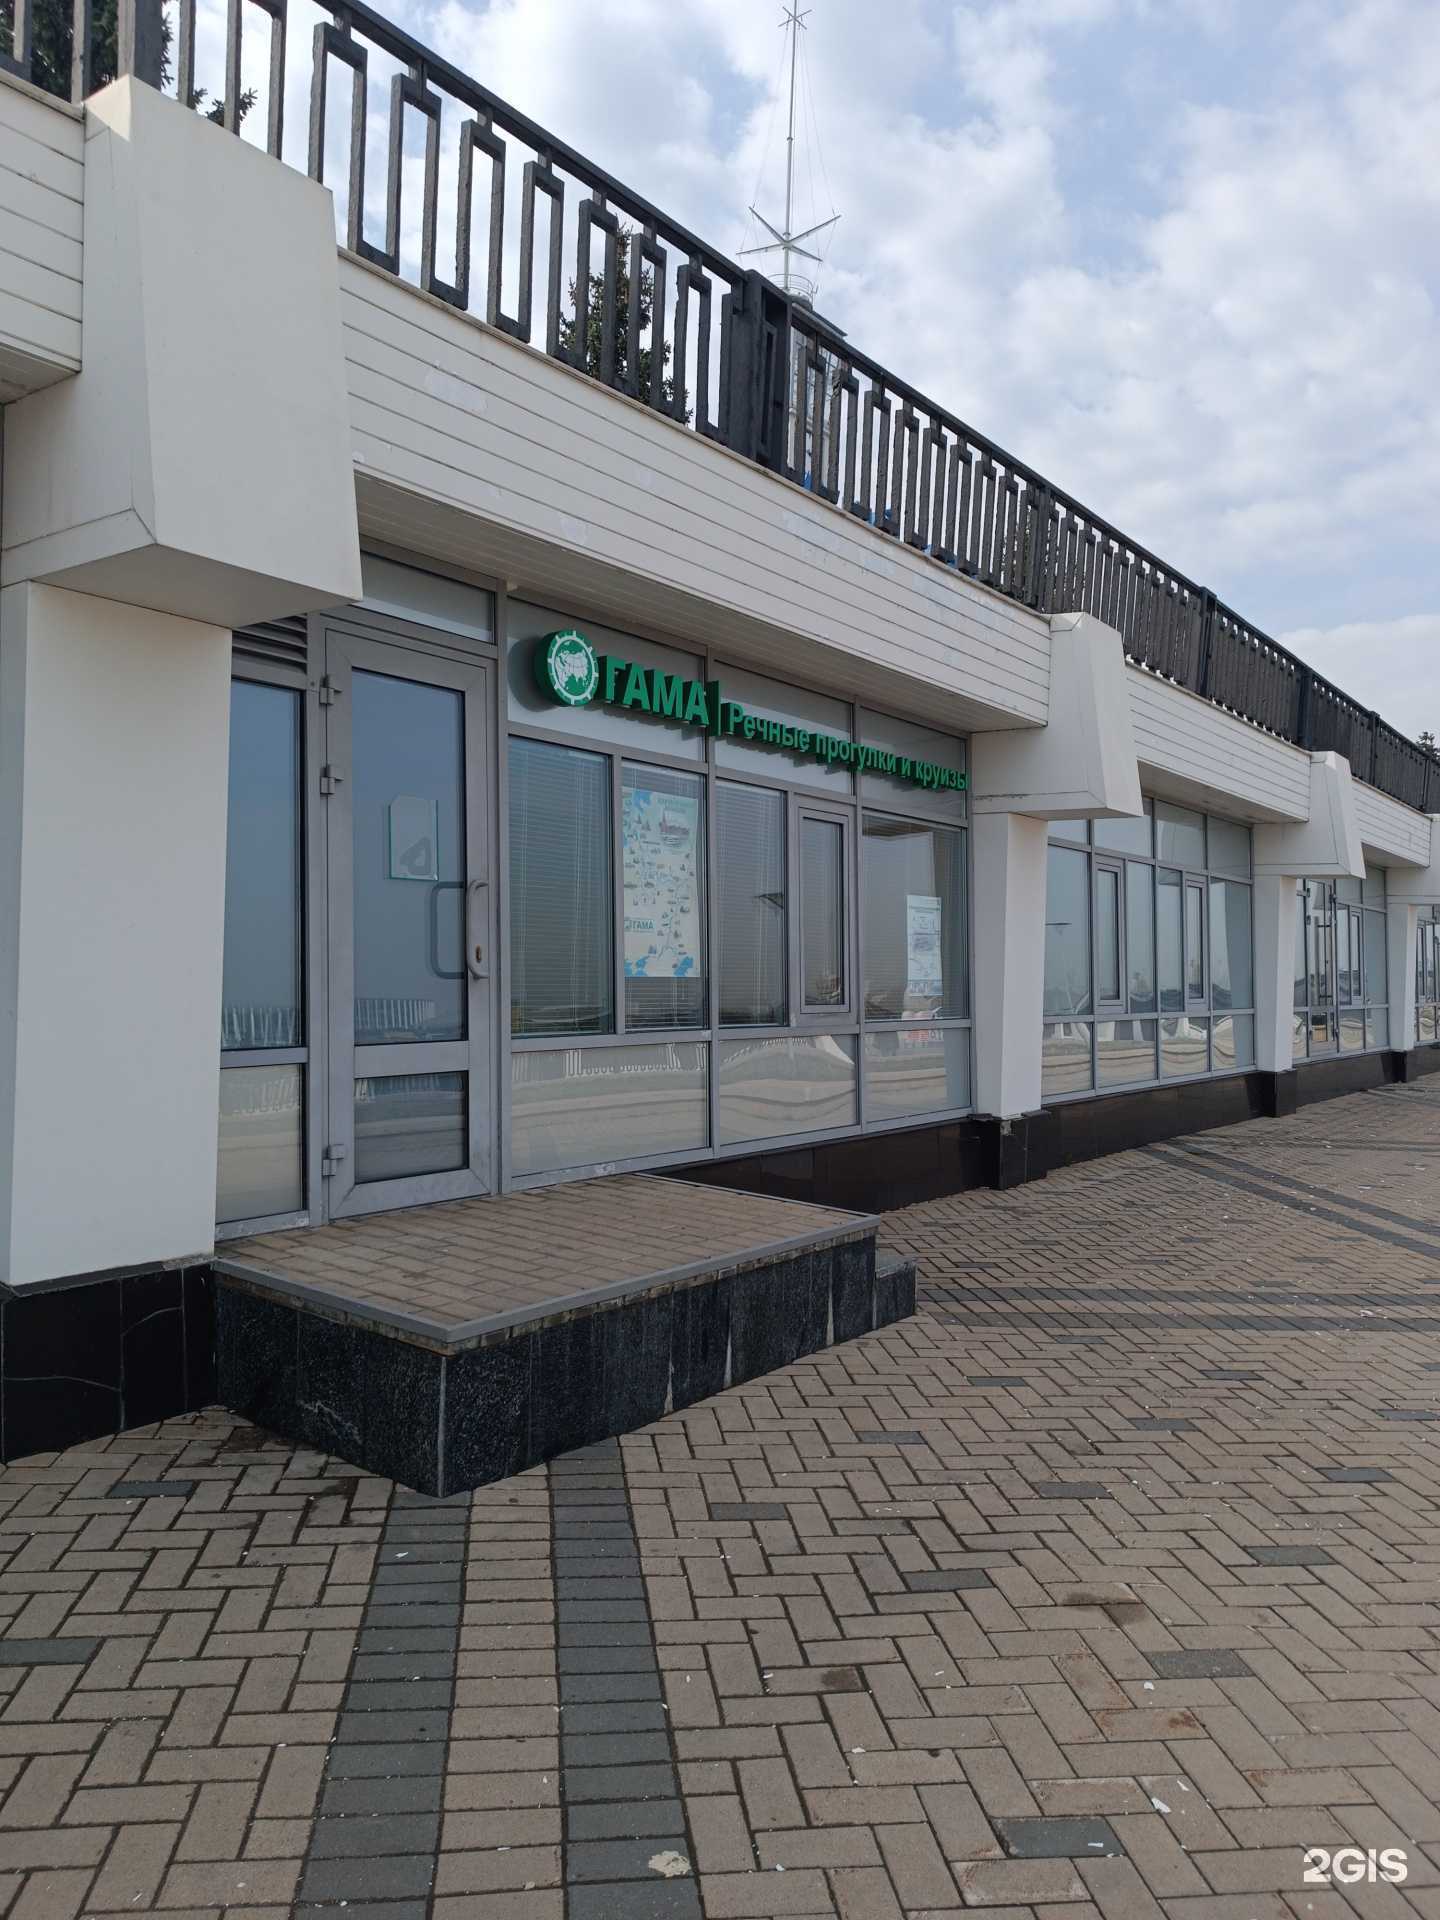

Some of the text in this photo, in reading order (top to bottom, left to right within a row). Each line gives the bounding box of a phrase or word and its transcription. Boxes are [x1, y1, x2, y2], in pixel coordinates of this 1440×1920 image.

[604, 655, 969, 790] ГАМА Речные прогулки и круизы
